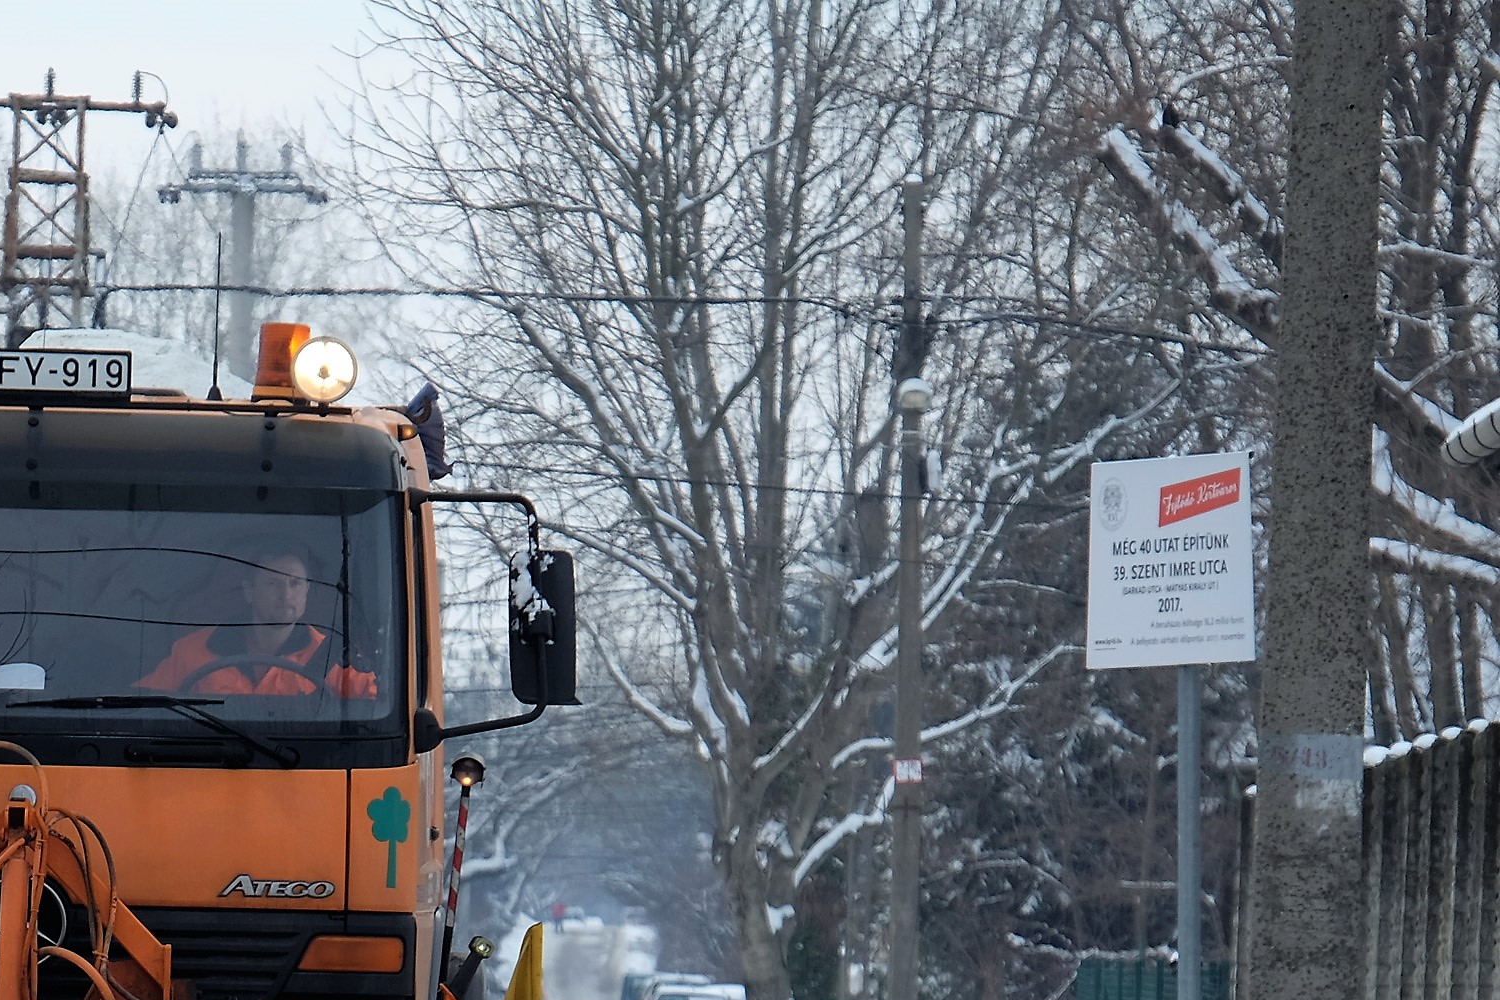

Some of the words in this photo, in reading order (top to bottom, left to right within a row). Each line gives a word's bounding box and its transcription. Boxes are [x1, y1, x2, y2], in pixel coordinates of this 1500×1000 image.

[1112, 537, 1137, 556] MÉG
[1139, 538, 1152, 555] 40
[1154, 537, 1180, 554] UTAT
[1113, 565, 1128, 581] 39.
[1131, 562, 1167, 580] SZENT
[1169, 560, 1196, 577] IMRE
[1199, 559, 1228, 576] UTCA
[1158, 597, 1183, 613] 2017.
[217, 873, 336, 899] ATEGO
